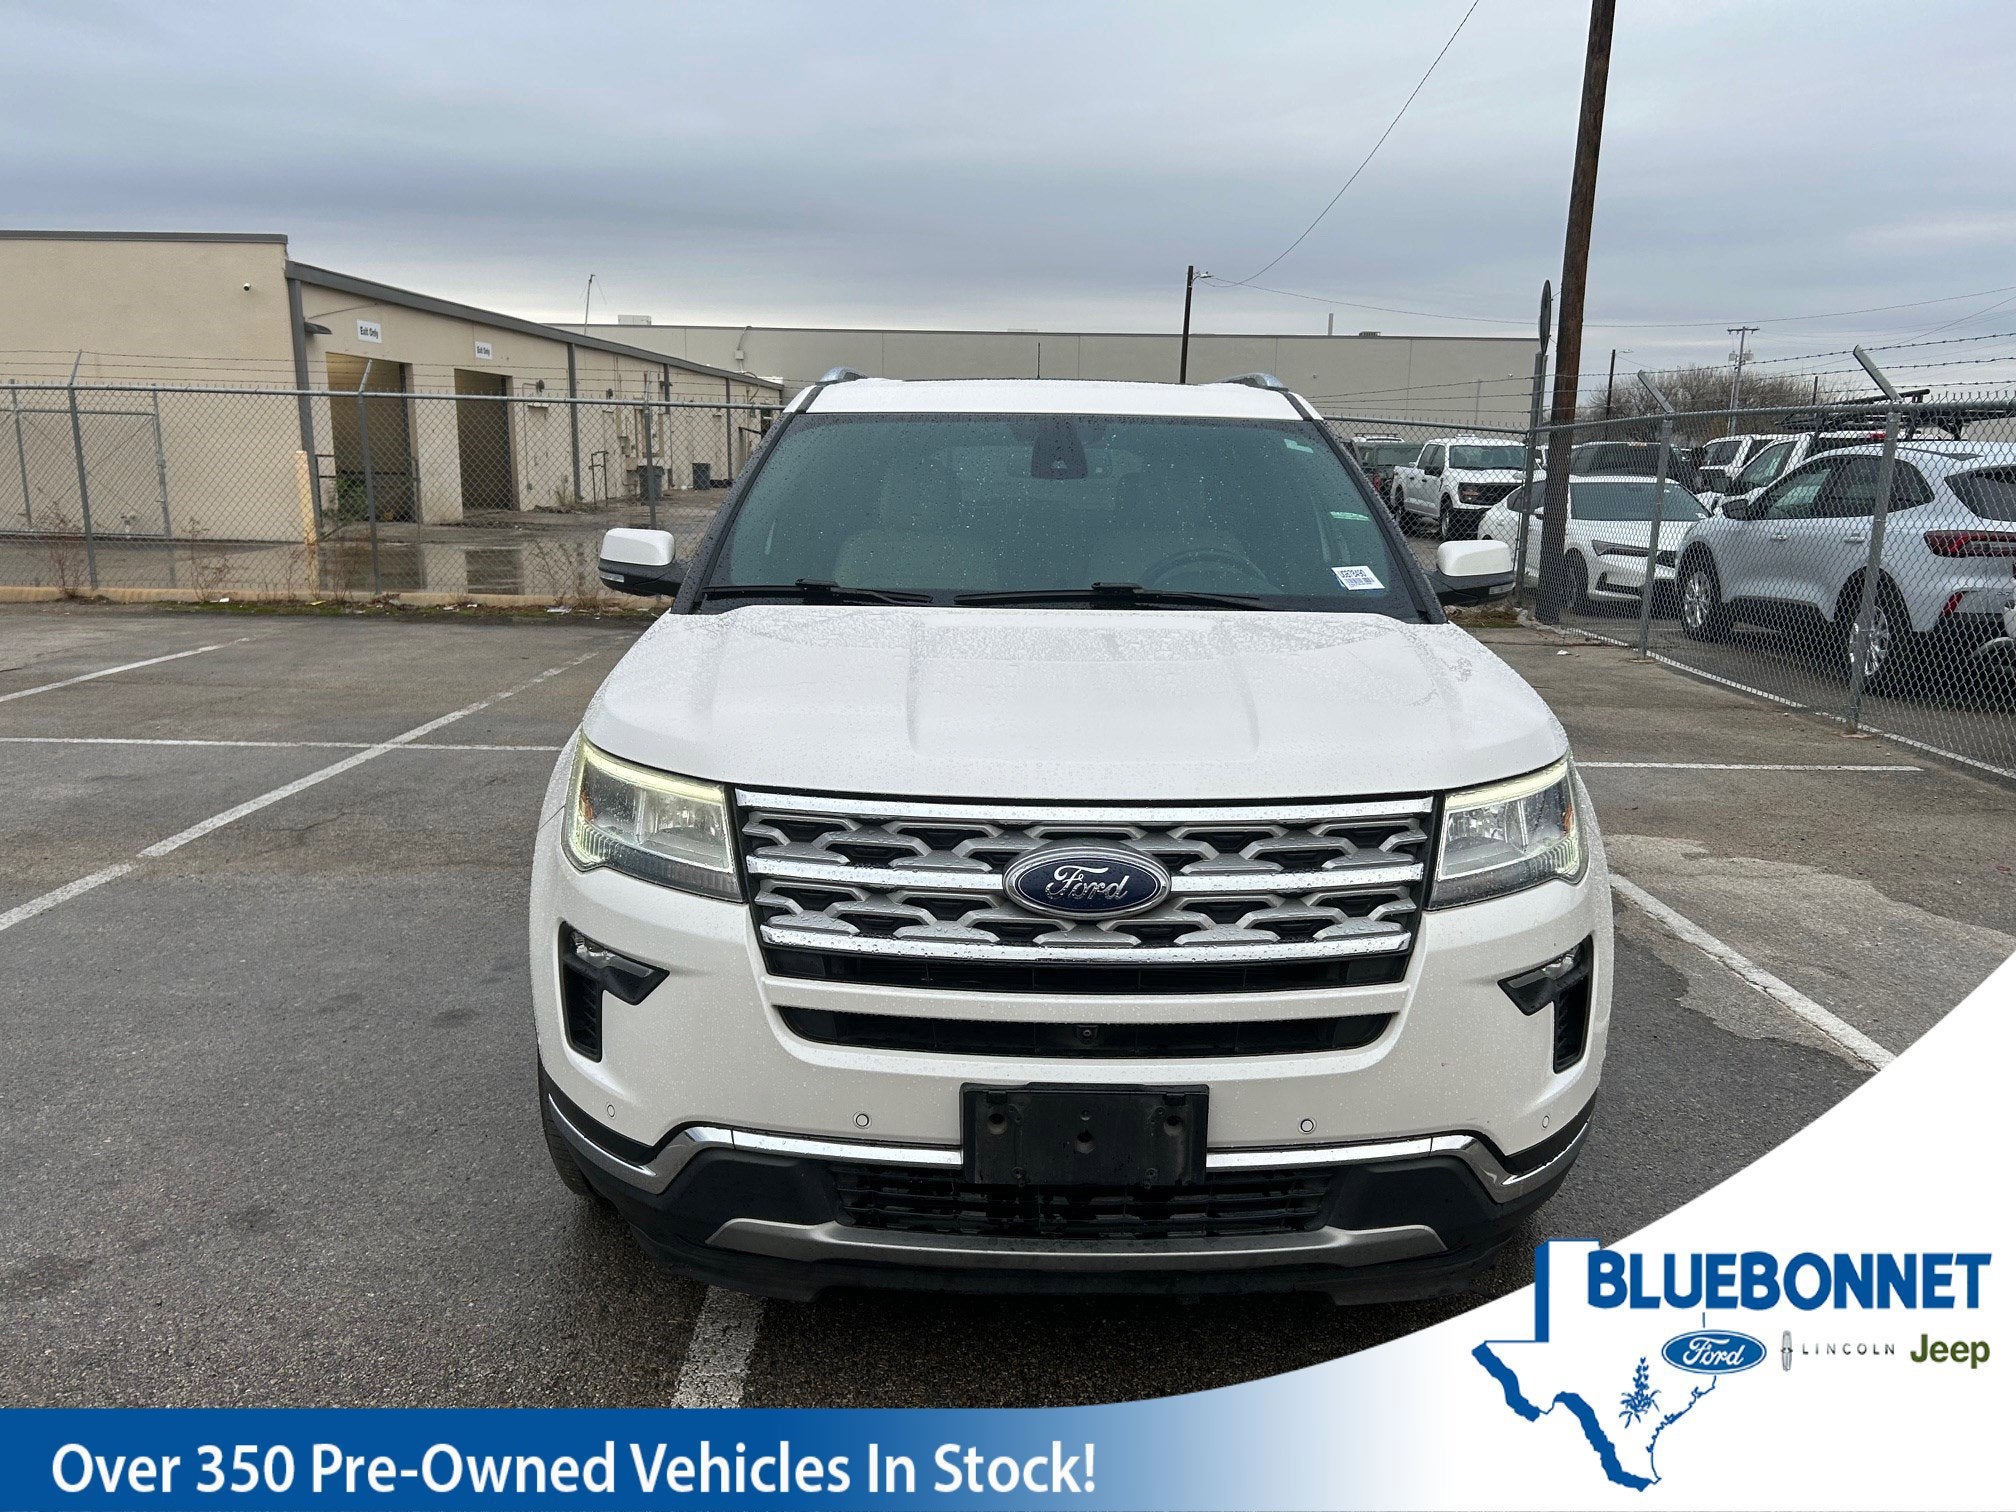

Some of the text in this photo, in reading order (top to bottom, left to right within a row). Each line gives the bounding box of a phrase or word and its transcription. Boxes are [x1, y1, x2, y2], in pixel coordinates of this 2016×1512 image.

[360, 326, 378, 339] Exit Only
[1045, 865, 1130, 900] Ford
